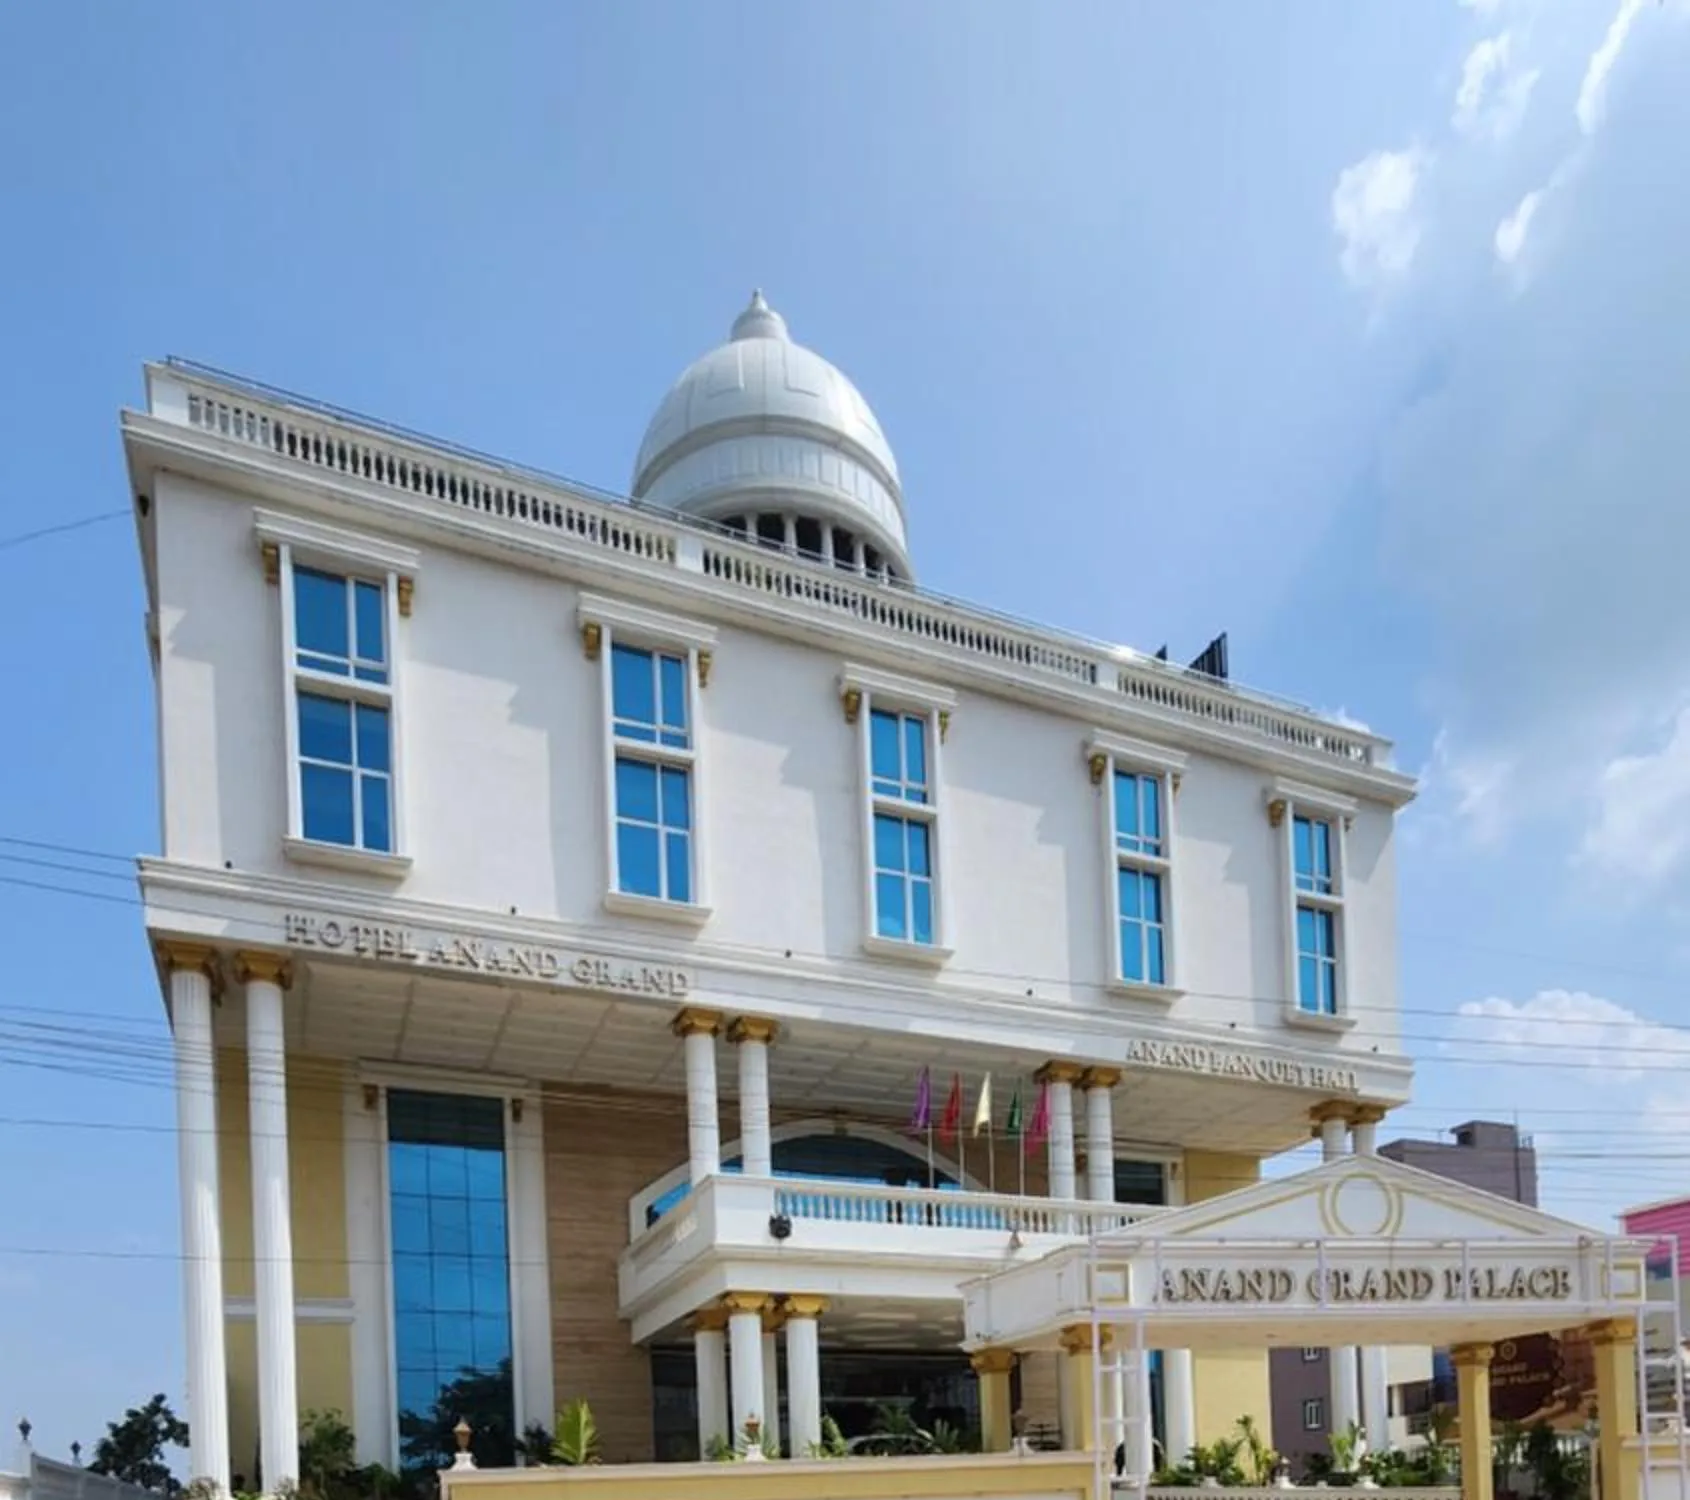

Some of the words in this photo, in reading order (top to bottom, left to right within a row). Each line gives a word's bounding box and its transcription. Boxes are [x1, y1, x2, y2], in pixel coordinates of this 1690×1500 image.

[286, 914, 418, 960] HOTEL
[429, 938, 560, 979] ANAND
[570, 958, 689, 997] GRAND
[1126, 1039, 1207, 1071] ANAND
[1308, 1065, 1360, 1092] HALL
[1153, 1267, 1295, 1303] ANAND
[1305, 1267, 1434, 1302] GRAND
[1443, 1267, 1572, 1302] PALACE
